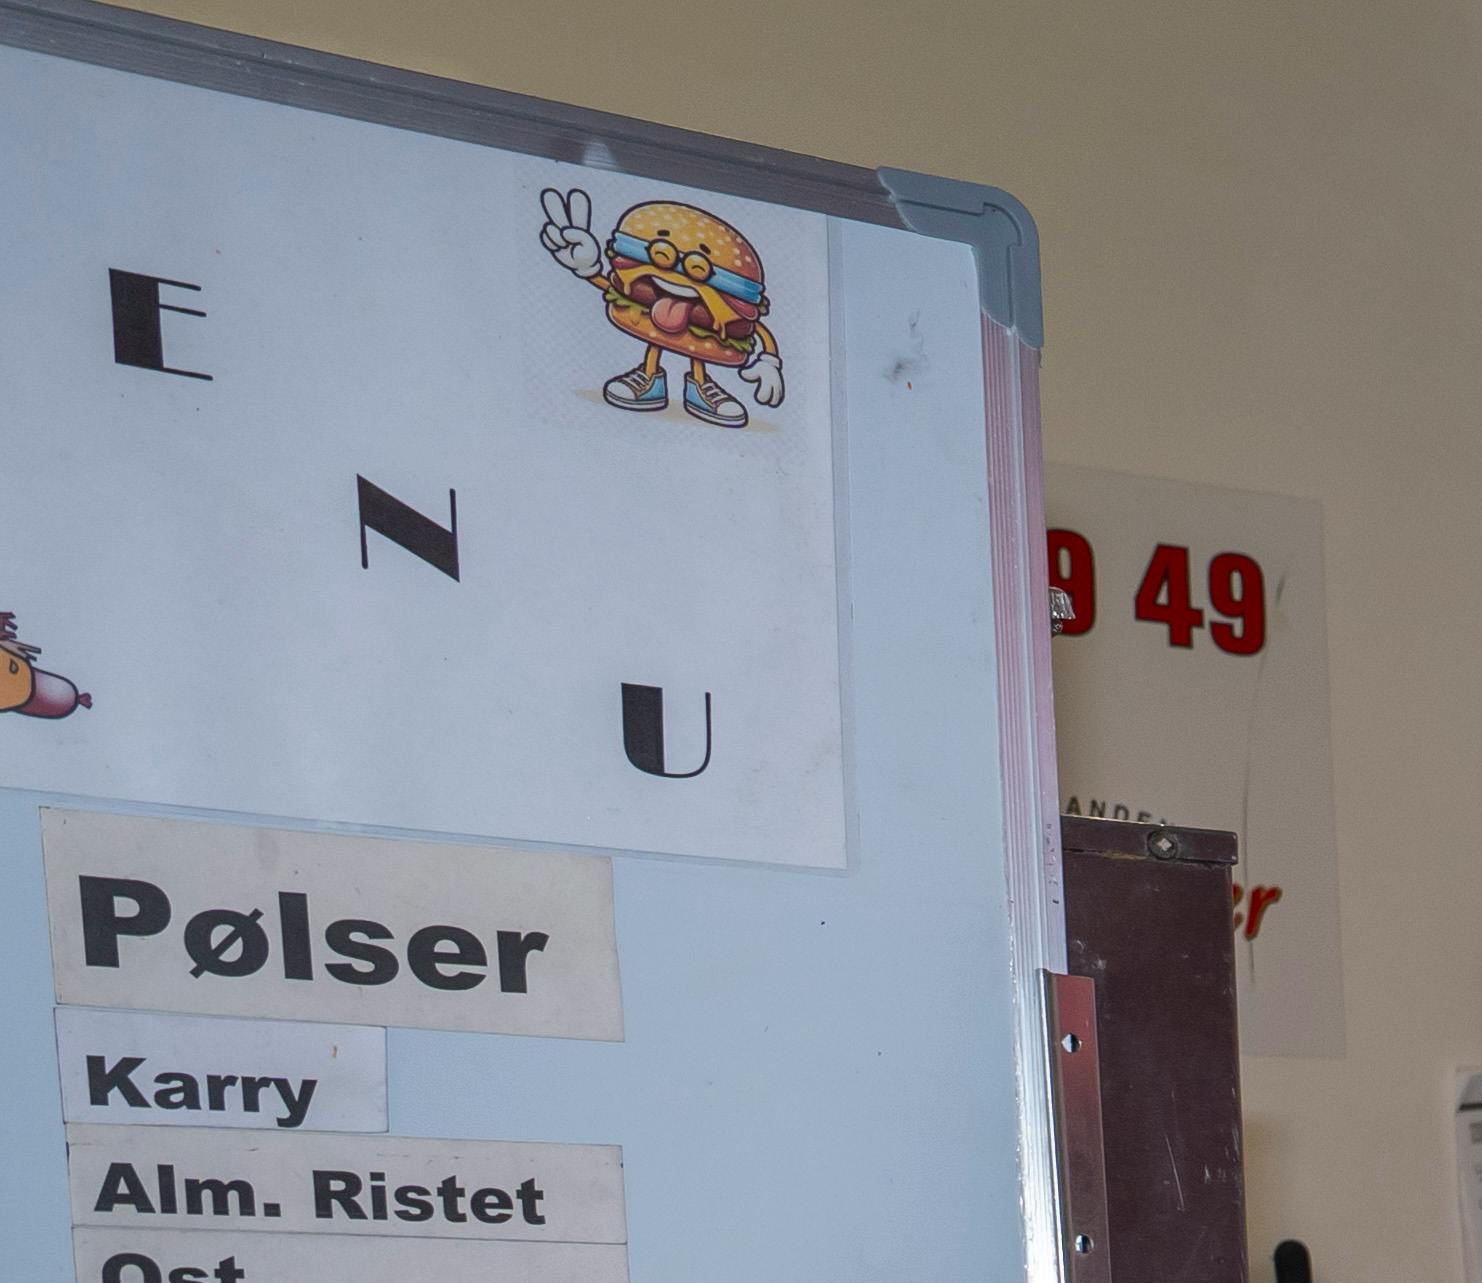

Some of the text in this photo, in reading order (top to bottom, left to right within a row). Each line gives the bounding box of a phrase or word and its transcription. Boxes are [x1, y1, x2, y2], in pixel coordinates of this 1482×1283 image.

[108, 267, 213, 382] E
[356, 473, 461, 583] N
[1134, 543, 1268, 657] 49
[620, 682, 712, 779] U
[78, 874, 551, 994] Pølser
[85, 1054, 318, 1128] Karry
[93, 1161, 547, 1226] Alm. Ristet
